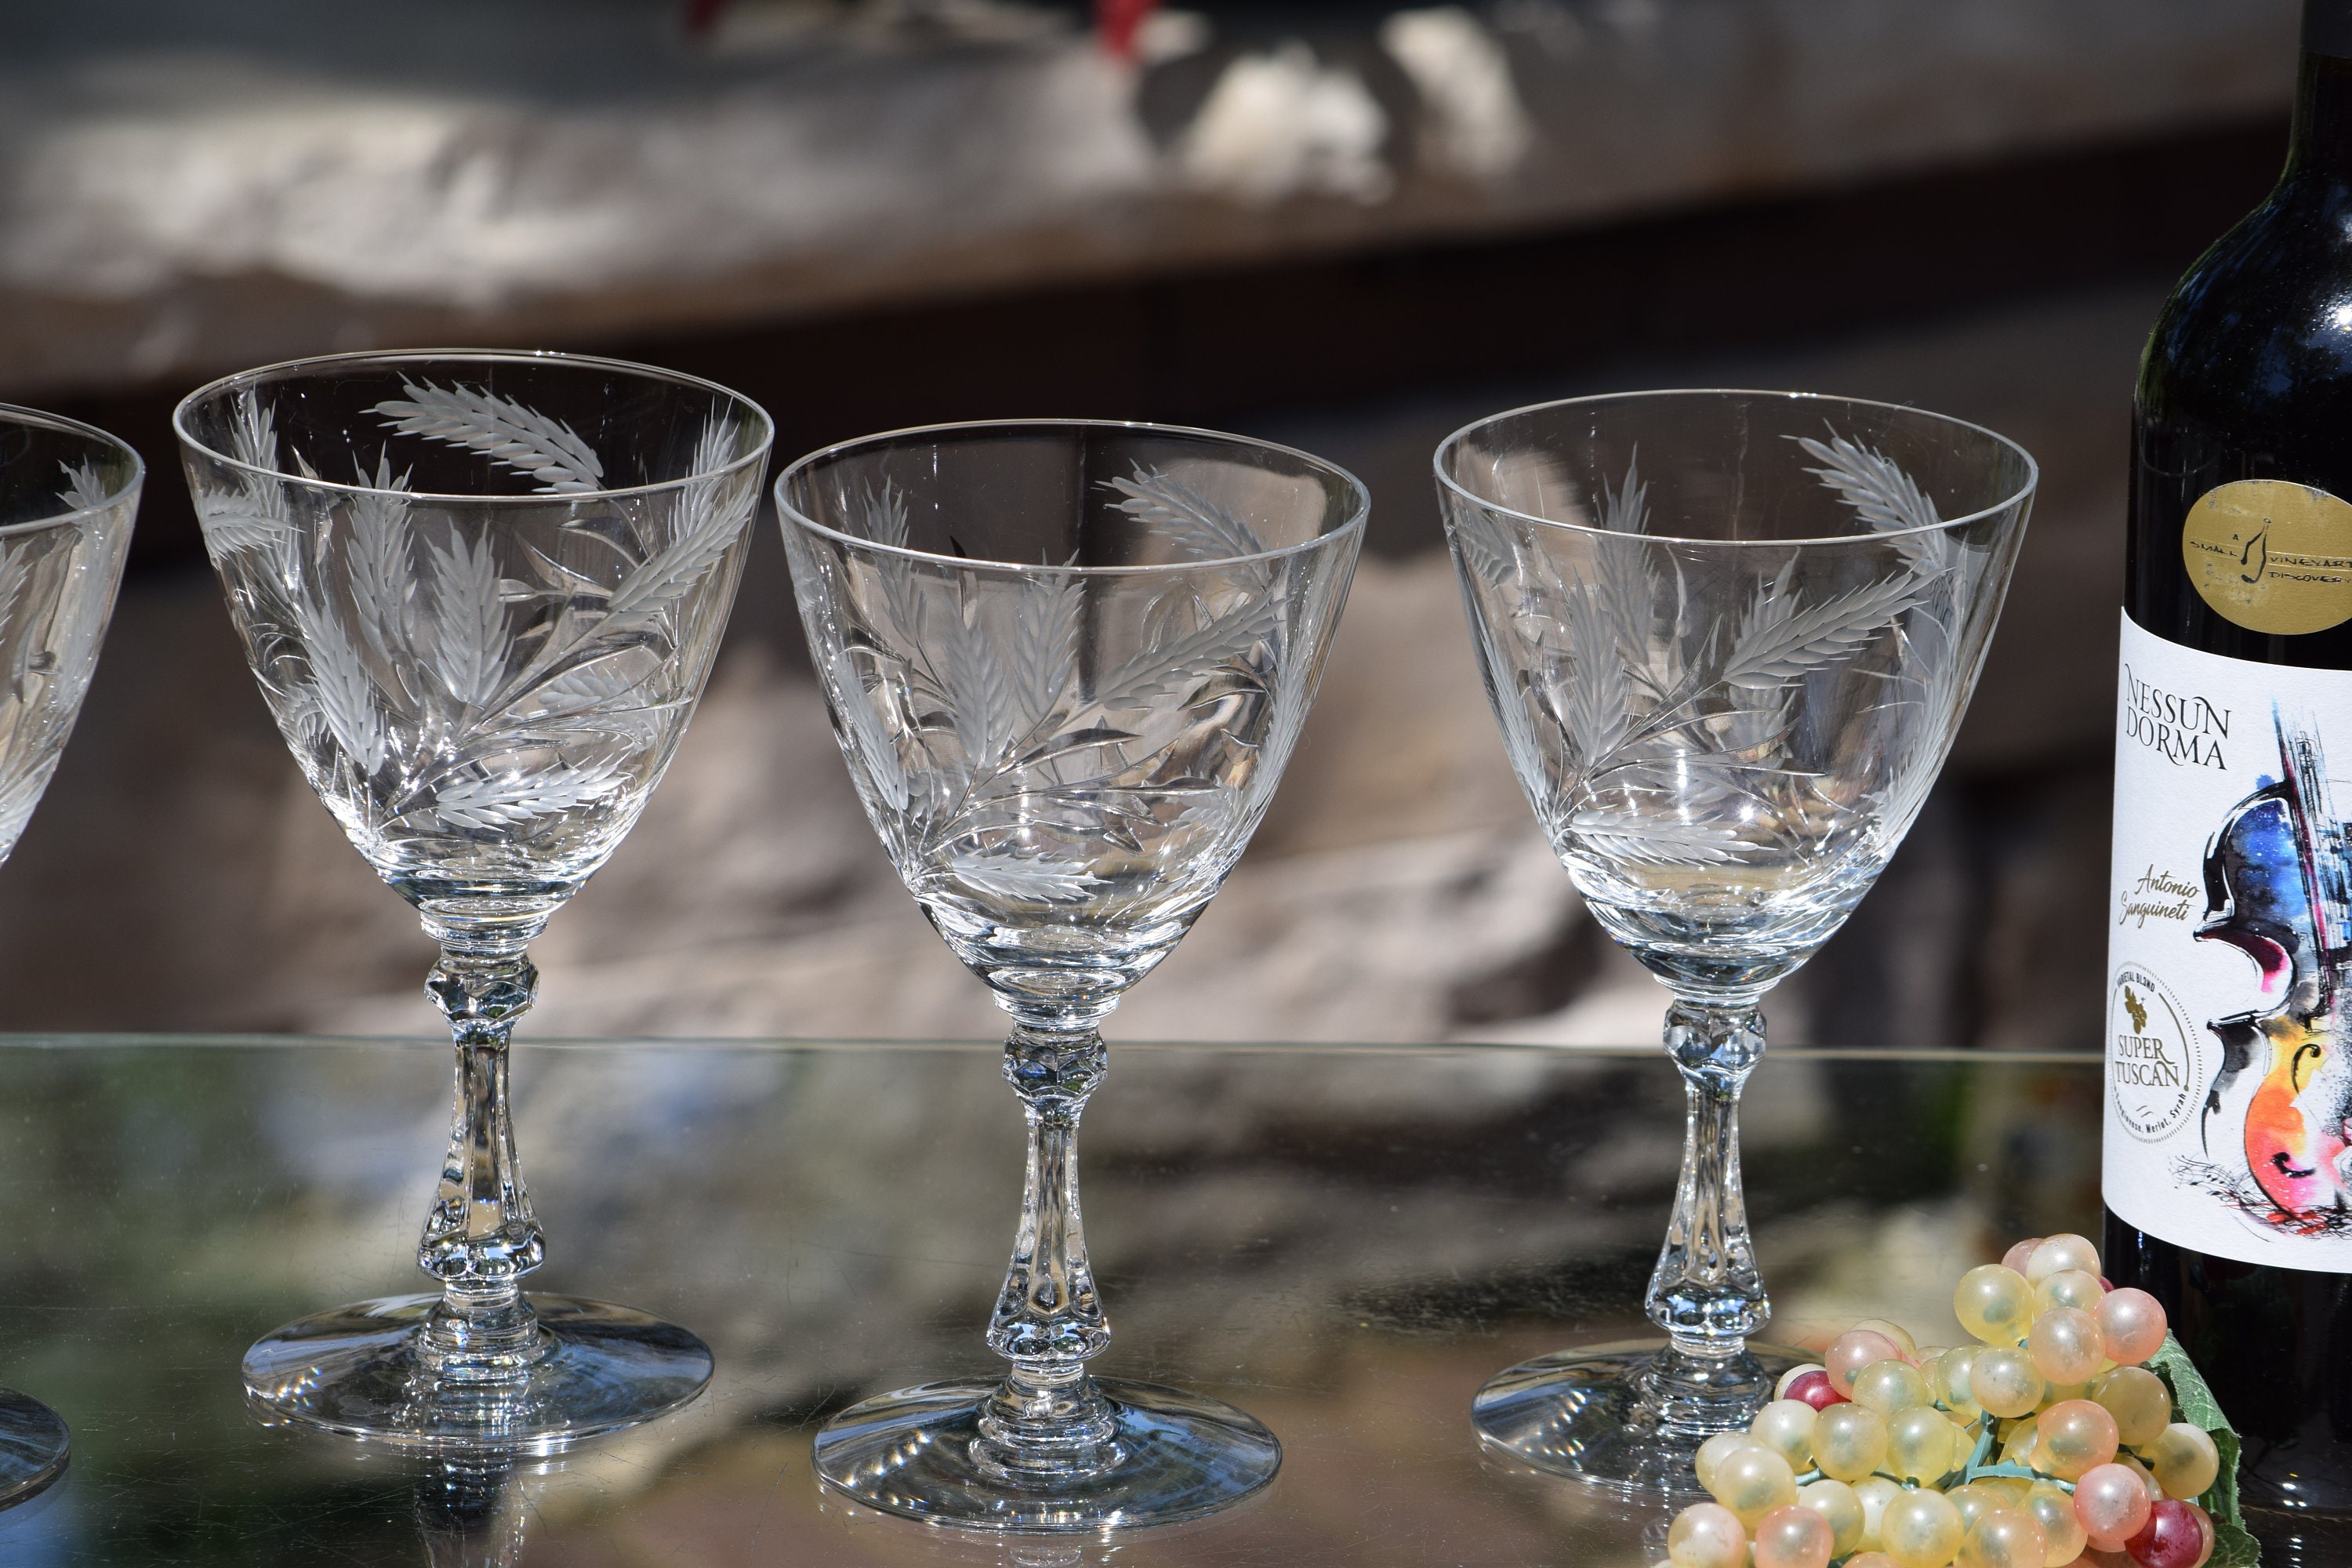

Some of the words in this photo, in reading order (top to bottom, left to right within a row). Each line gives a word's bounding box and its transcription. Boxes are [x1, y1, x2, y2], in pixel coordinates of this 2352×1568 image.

[2190, 541, 2239, 557] SMALL
[2267, 570, 2351, 583] DISCOVERY
[2125, 663, 2233, 739] NESSUN
[2126, 706, 2227, 771] DORMA
[2134, 863, 2201, 898] Antonio
[2119, 890, 2195, 929] Sanguineti
[2118, 1034, 2176, 1065] SUPER
[2115, 1060, 2180, 1087] TUSCAN
[2169, 1092, 2187, 1119] Syrah
